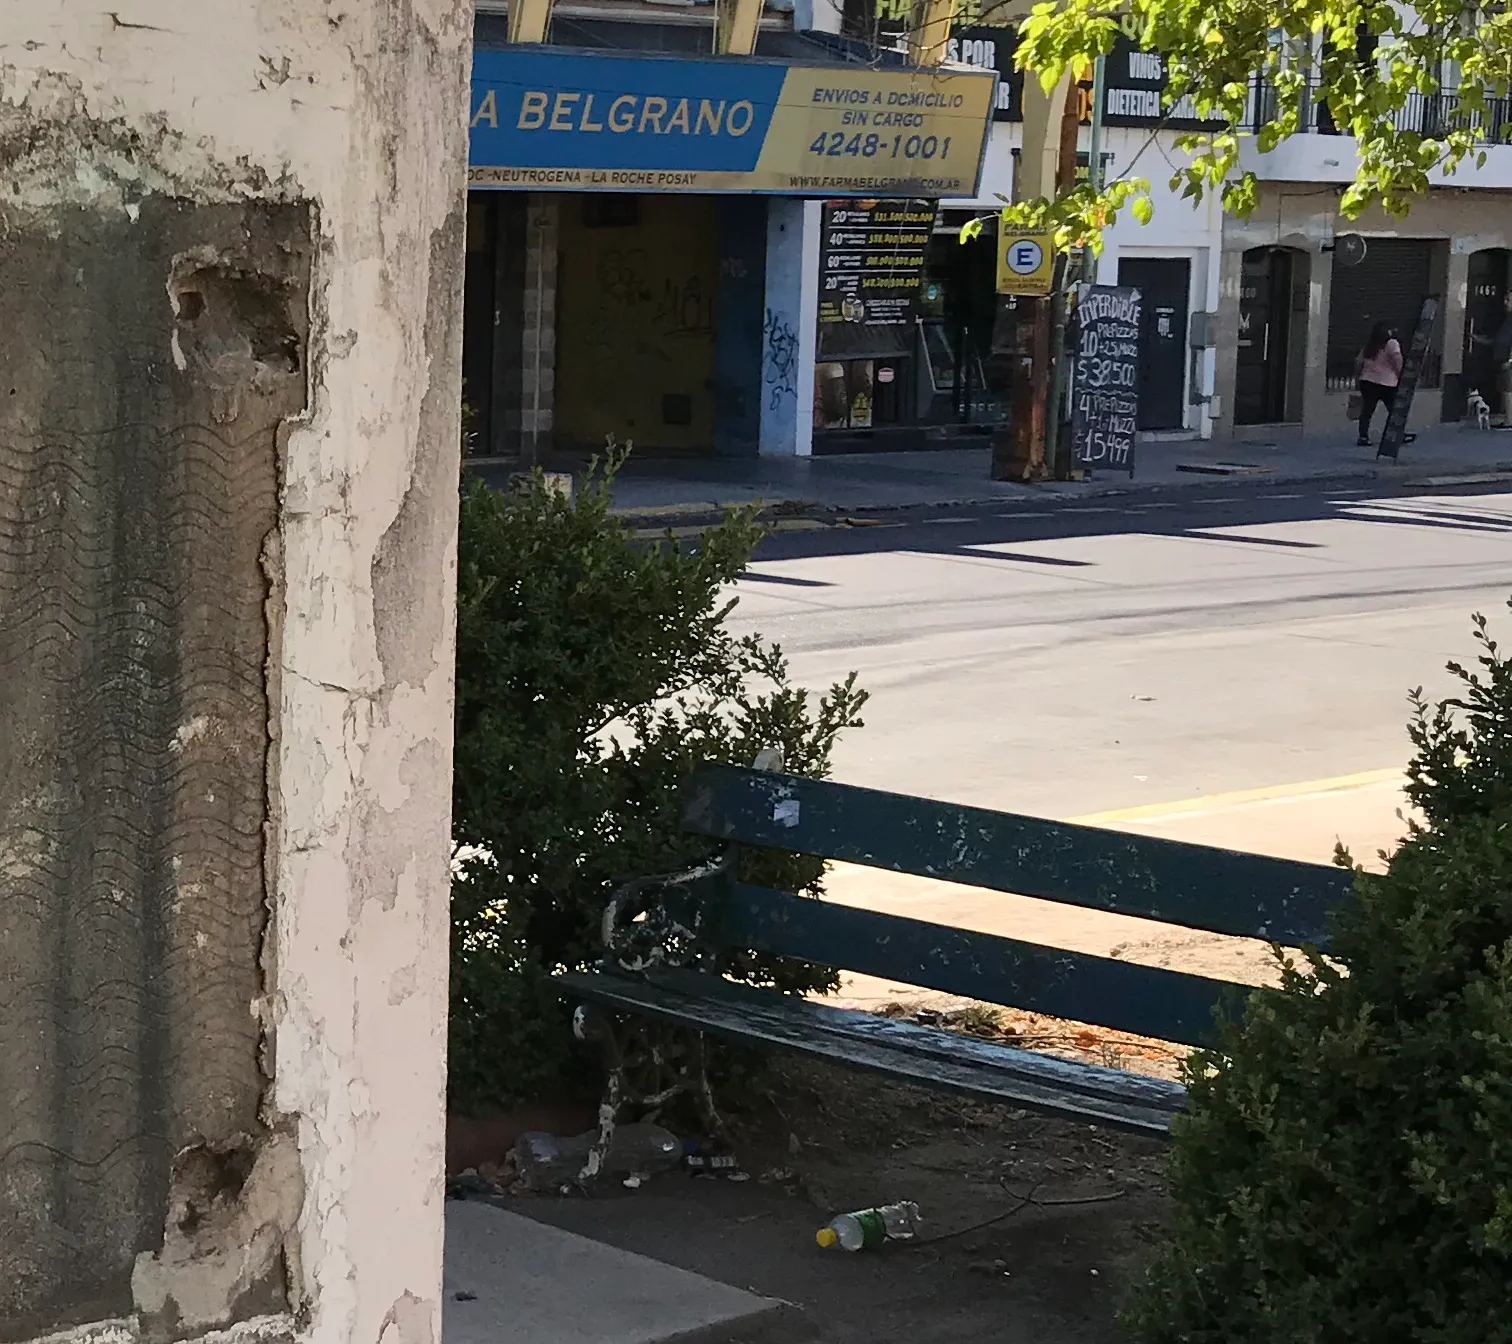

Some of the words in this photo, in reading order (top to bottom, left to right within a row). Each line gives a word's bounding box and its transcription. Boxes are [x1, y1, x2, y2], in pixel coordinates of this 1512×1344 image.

[962, 39, 995, 69] POR
[1128, 52, 1162, 80] VINOS
[812, 87, 870, 105] ENVIOS
[872, 91, 882, 105] A
[887, 91, 963, 108] DOMICILIO
[1107, 88, 1161, 117] DIETETICA
[516, 90, 754, 137] BELGRANO
[841, 111, 867, 126] SIN
[872, 113, 924, 128] CARGO
[809, 131, 952, 160] 4248-1001
[611, 171, 654, 184] ROCHE
[657, 172, 697, 186] POSAY
[1016, 248, 1034, 266] E
[1079, 329, 1098, 357] 10
[1079, 394, 1090, 422] 4
